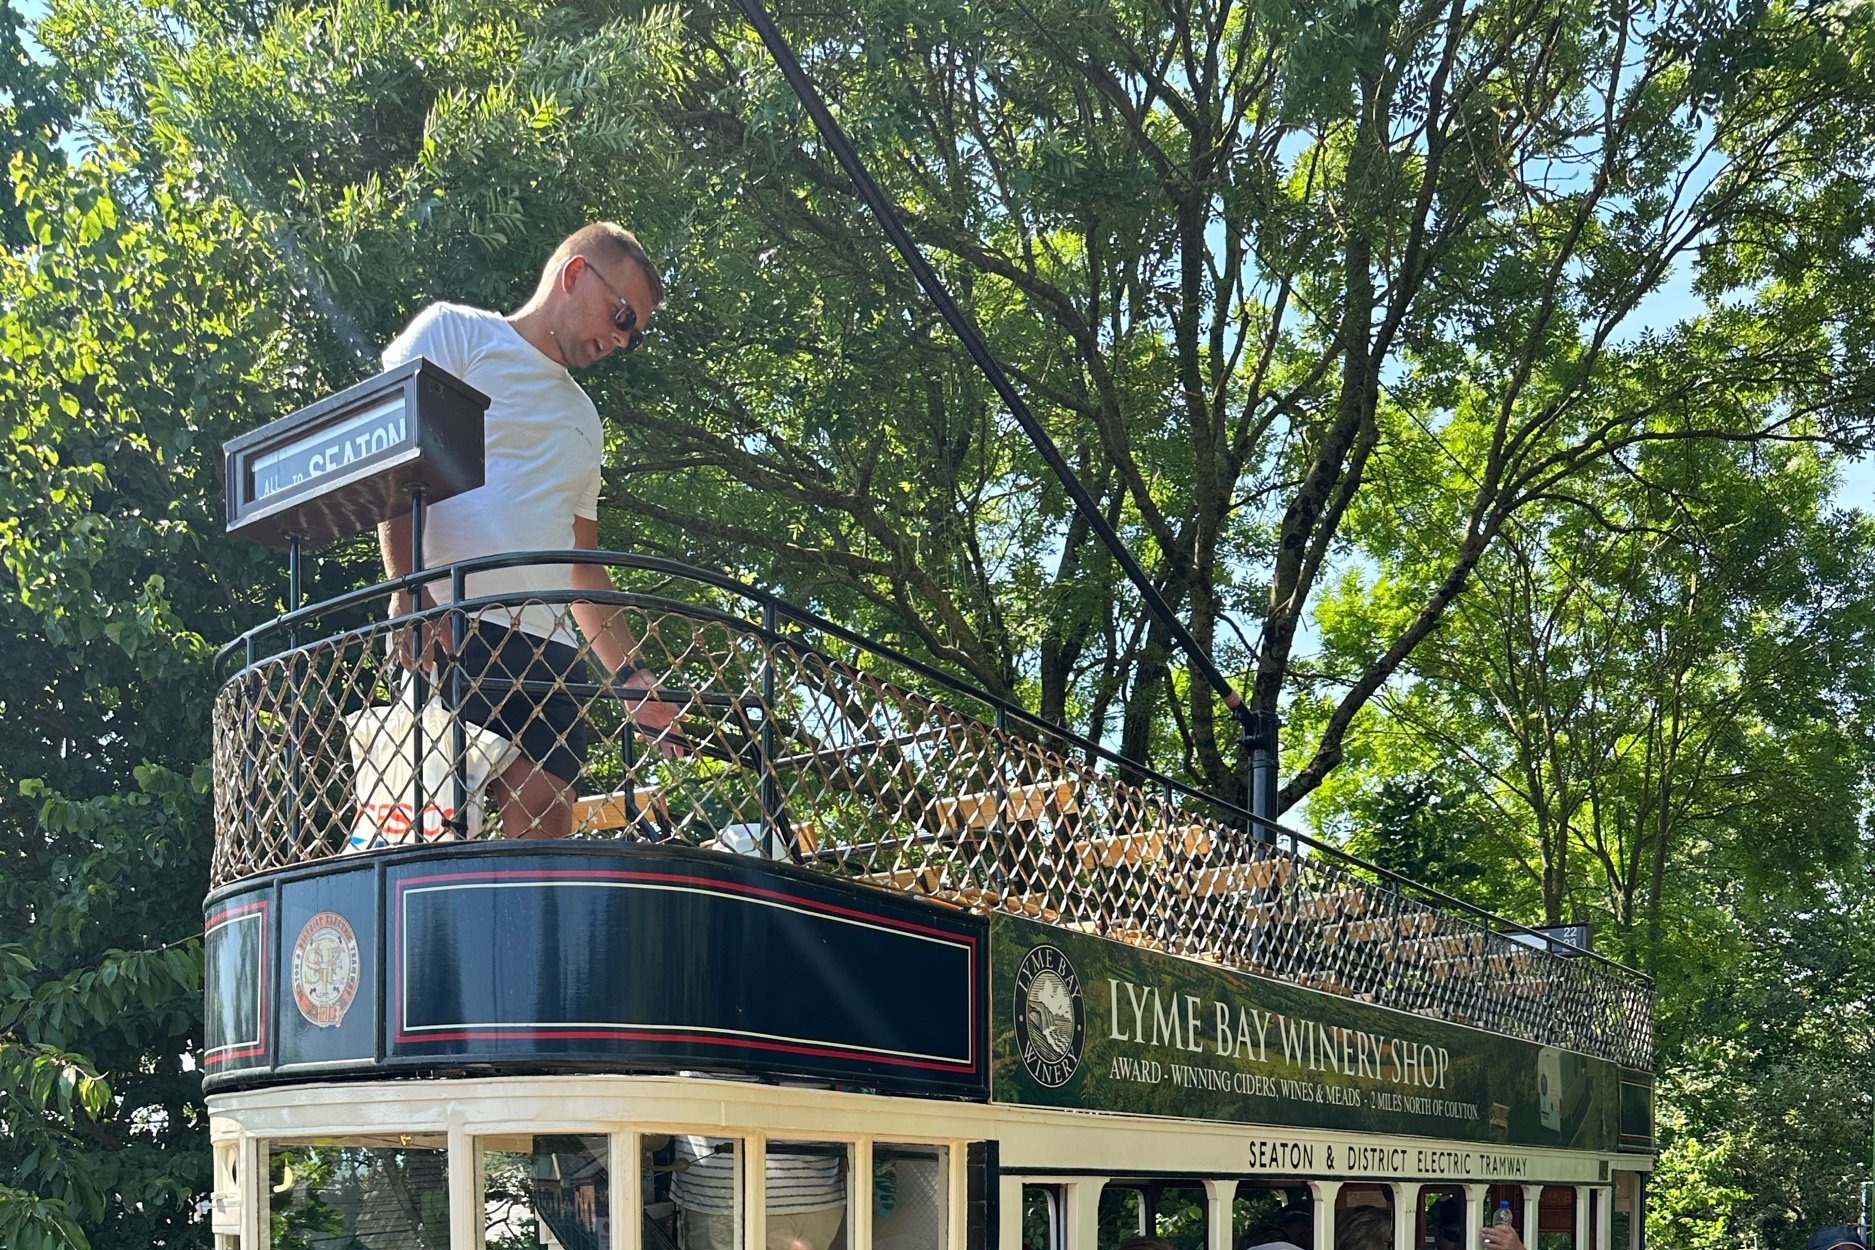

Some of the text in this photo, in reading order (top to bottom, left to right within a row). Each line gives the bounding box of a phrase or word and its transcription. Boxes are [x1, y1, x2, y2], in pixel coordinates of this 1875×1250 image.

[265, 417, 406, 495] ALL TO SEATON
[1563, 926, 1578, 938] 22
[1018, 949, 1081, 999] LYME BAY
[1107, 978, 1450, 1090] LYME BAY WINERY SHOP
[1023, 1040, 1078, 1084] WINERY
[1109, 1056, 1162, 1084] AWARD
[1170, 1063, 1231, 1092] WINNING
[1234, 1072, 1279, 1101] CIDERS,
[1280, 1078, 1314, 1103] WINES
[1315, 1084, 1324, 1104] &
[1326, 1085, 1361, 1107] MEADS
[1371, 1091, 1376, 1109] 2
[1377, 1092, 1402, 1112] MILES
[1403, 1096, 1432, 1116] NORTH
[1432, 1099, 1443, 1117] OF
[1249, 1140, 1528, 1177] SEATON & DISTRICT ELECTRIC TRAMWAY
